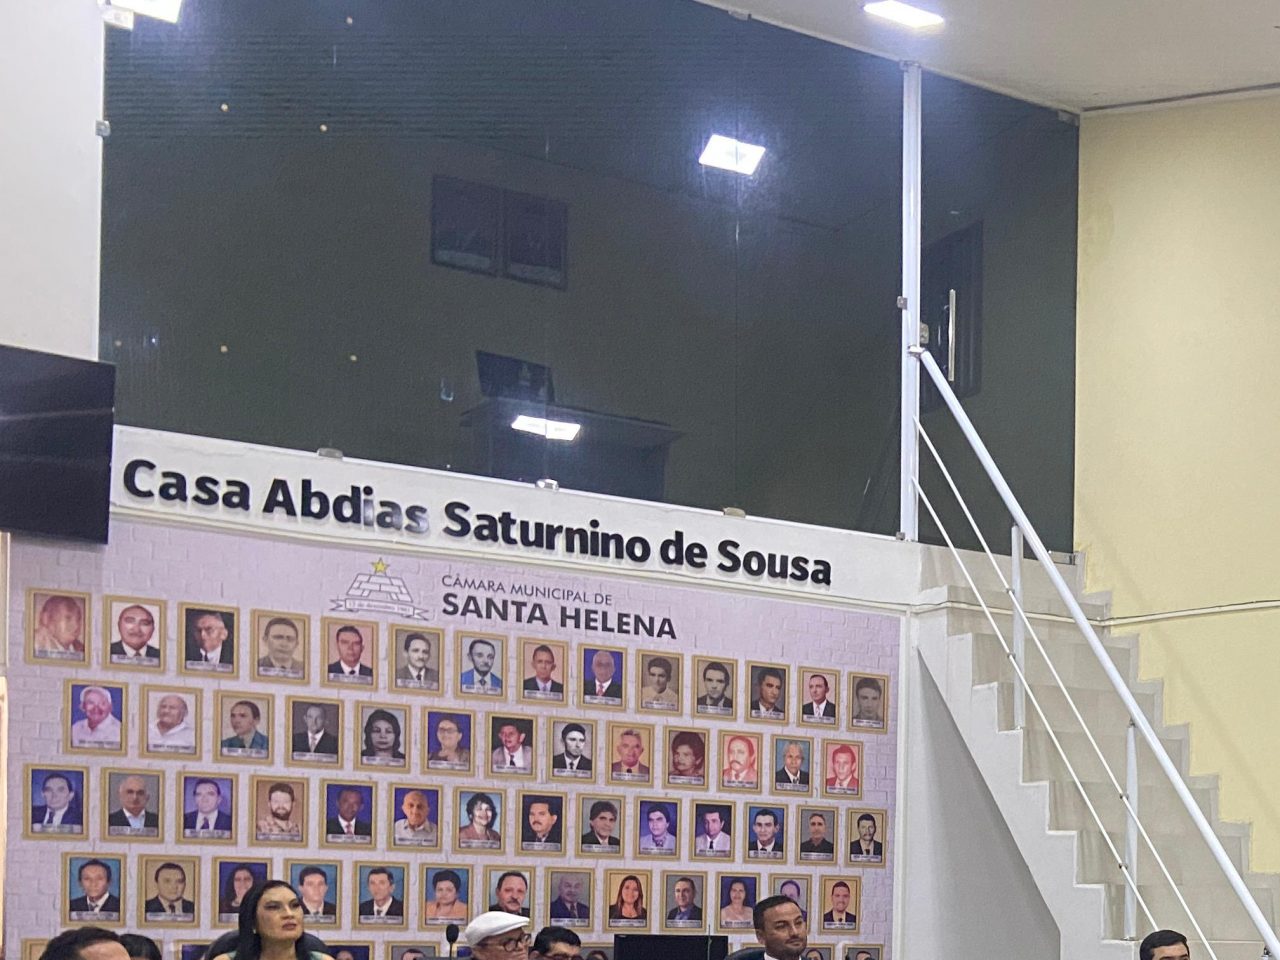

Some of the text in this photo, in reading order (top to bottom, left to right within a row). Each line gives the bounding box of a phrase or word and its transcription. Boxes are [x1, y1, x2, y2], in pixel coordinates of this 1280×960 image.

[123, 459, 833, 586] Casa Abdias Saturnino de Sousa
[441, 574, 613, 607] CÂMARA MUNICIPAL DE
[442, 591, 549, 626] SANTA
[560, 605, 677, 640] HELENA
